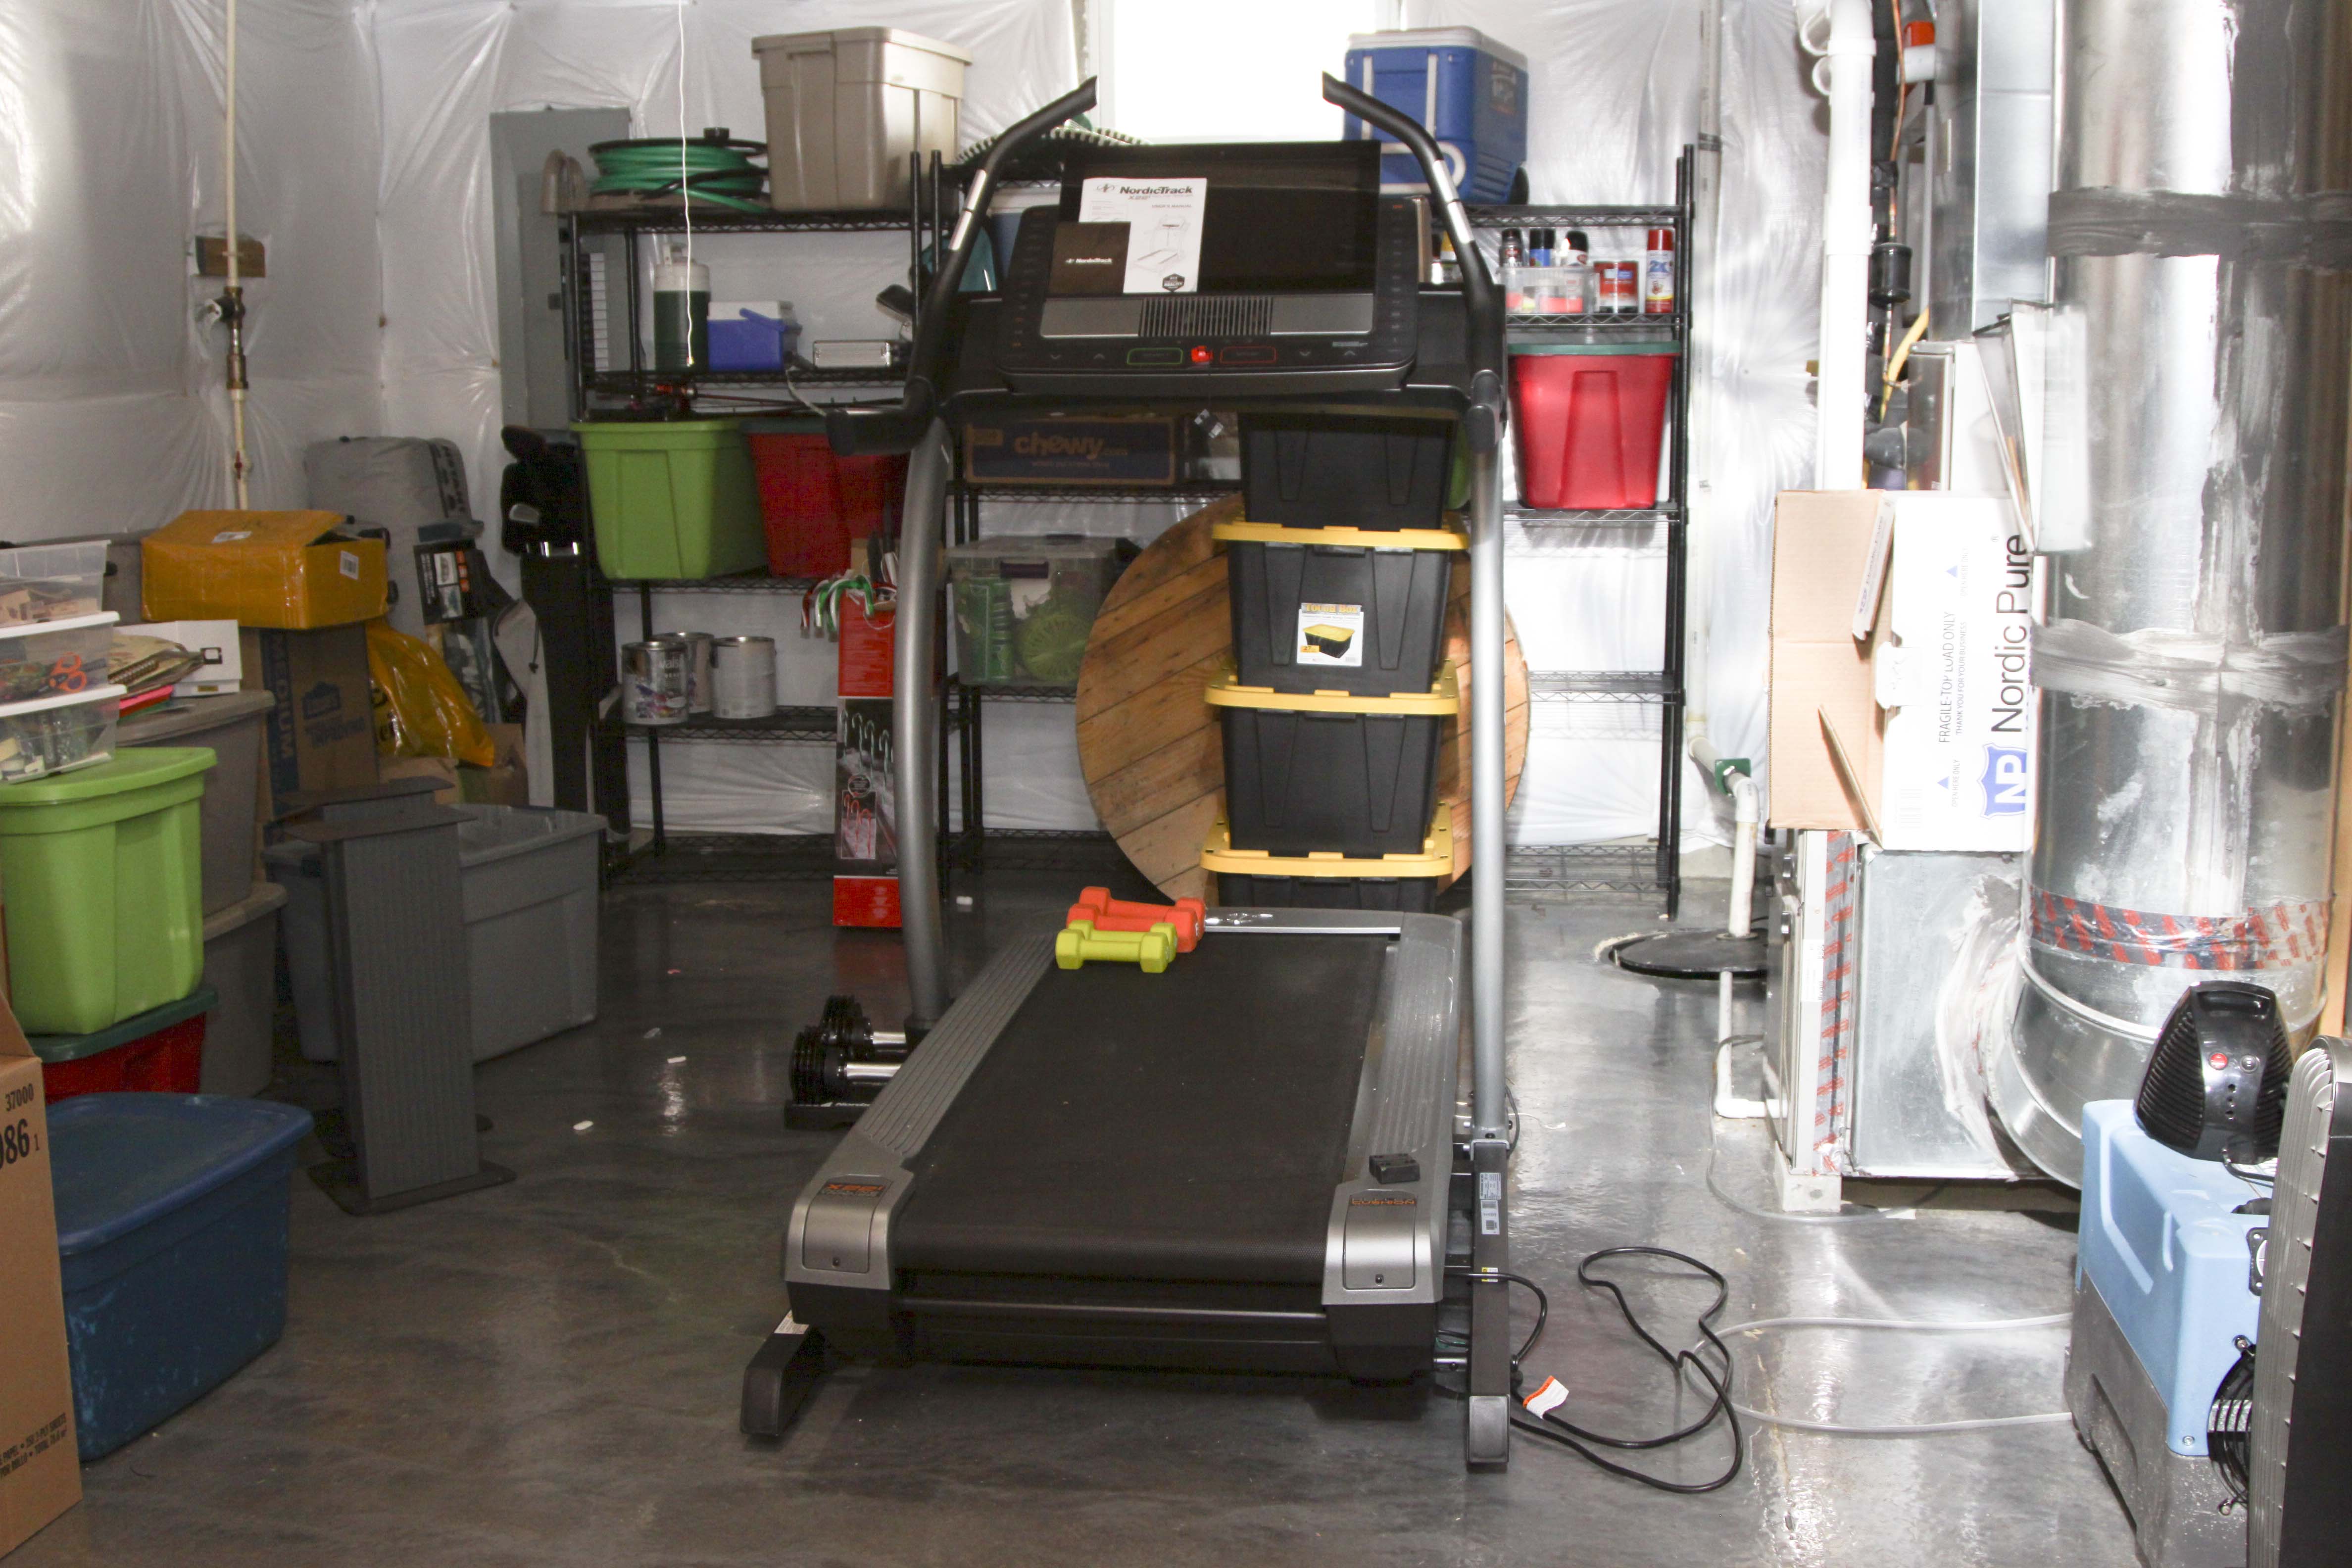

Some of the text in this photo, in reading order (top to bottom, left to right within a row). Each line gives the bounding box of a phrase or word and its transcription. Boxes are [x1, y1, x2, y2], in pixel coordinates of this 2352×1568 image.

[1120, 186, 1192, 194] NordicTrack
[1943, 611, 1956, 640] ONLY
[1959, 621, 1967, 655] BUSINESS
[1991, 534, 2030, 733] Nordic Pure
[1956, 711, 1964, 736] THANK
[1995, 754, 2027, 804] NP
[4, 1082, 35, 1112] 37000
